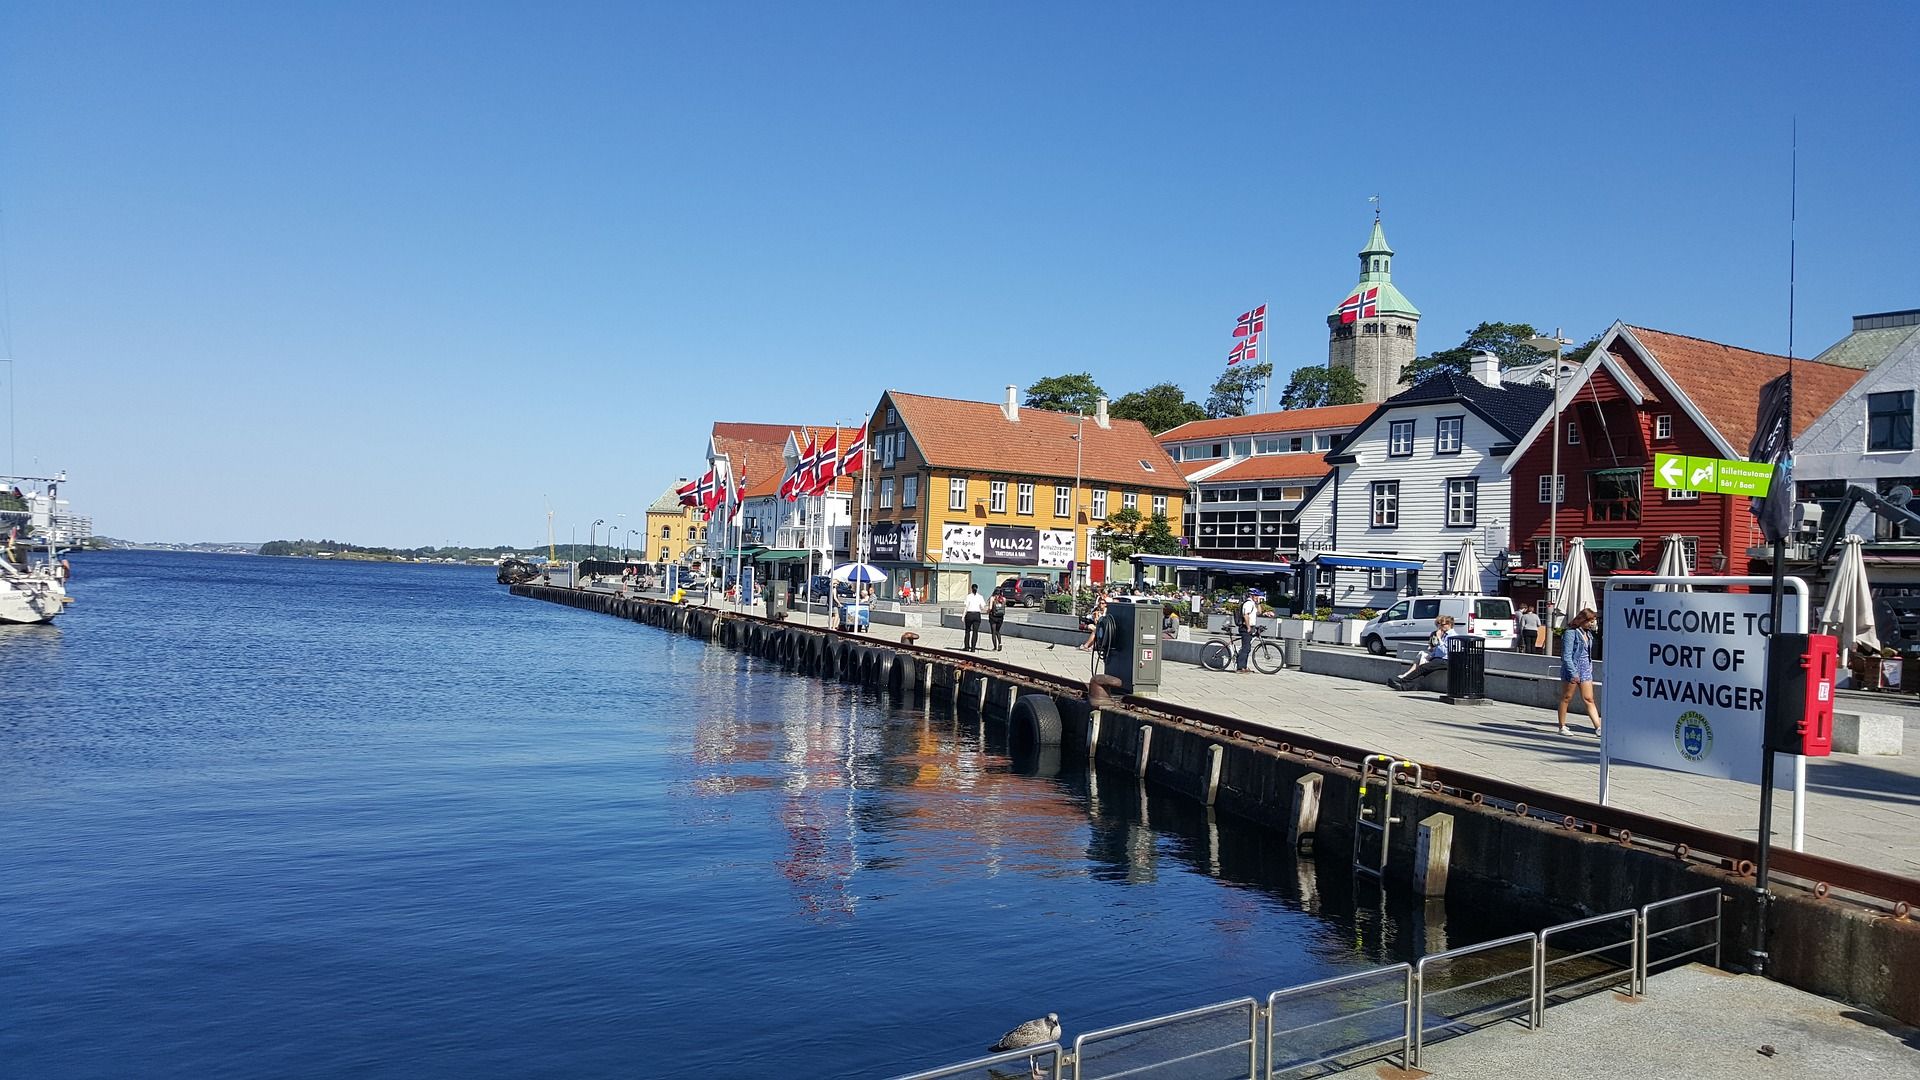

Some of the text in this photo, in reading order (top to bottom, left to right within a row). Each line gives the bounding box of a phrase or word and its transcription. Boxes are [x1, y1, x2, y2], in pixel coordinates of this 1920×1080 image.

[989, 537, 1033, 550] VILLA22
[1551, 564, 1559, 578] P
[1624, 608, 1772, 637] WELCOME TO
[1650, 643, 1745, 671] PORT OF
[1632, 675, 1764, 711] STAVANGER
